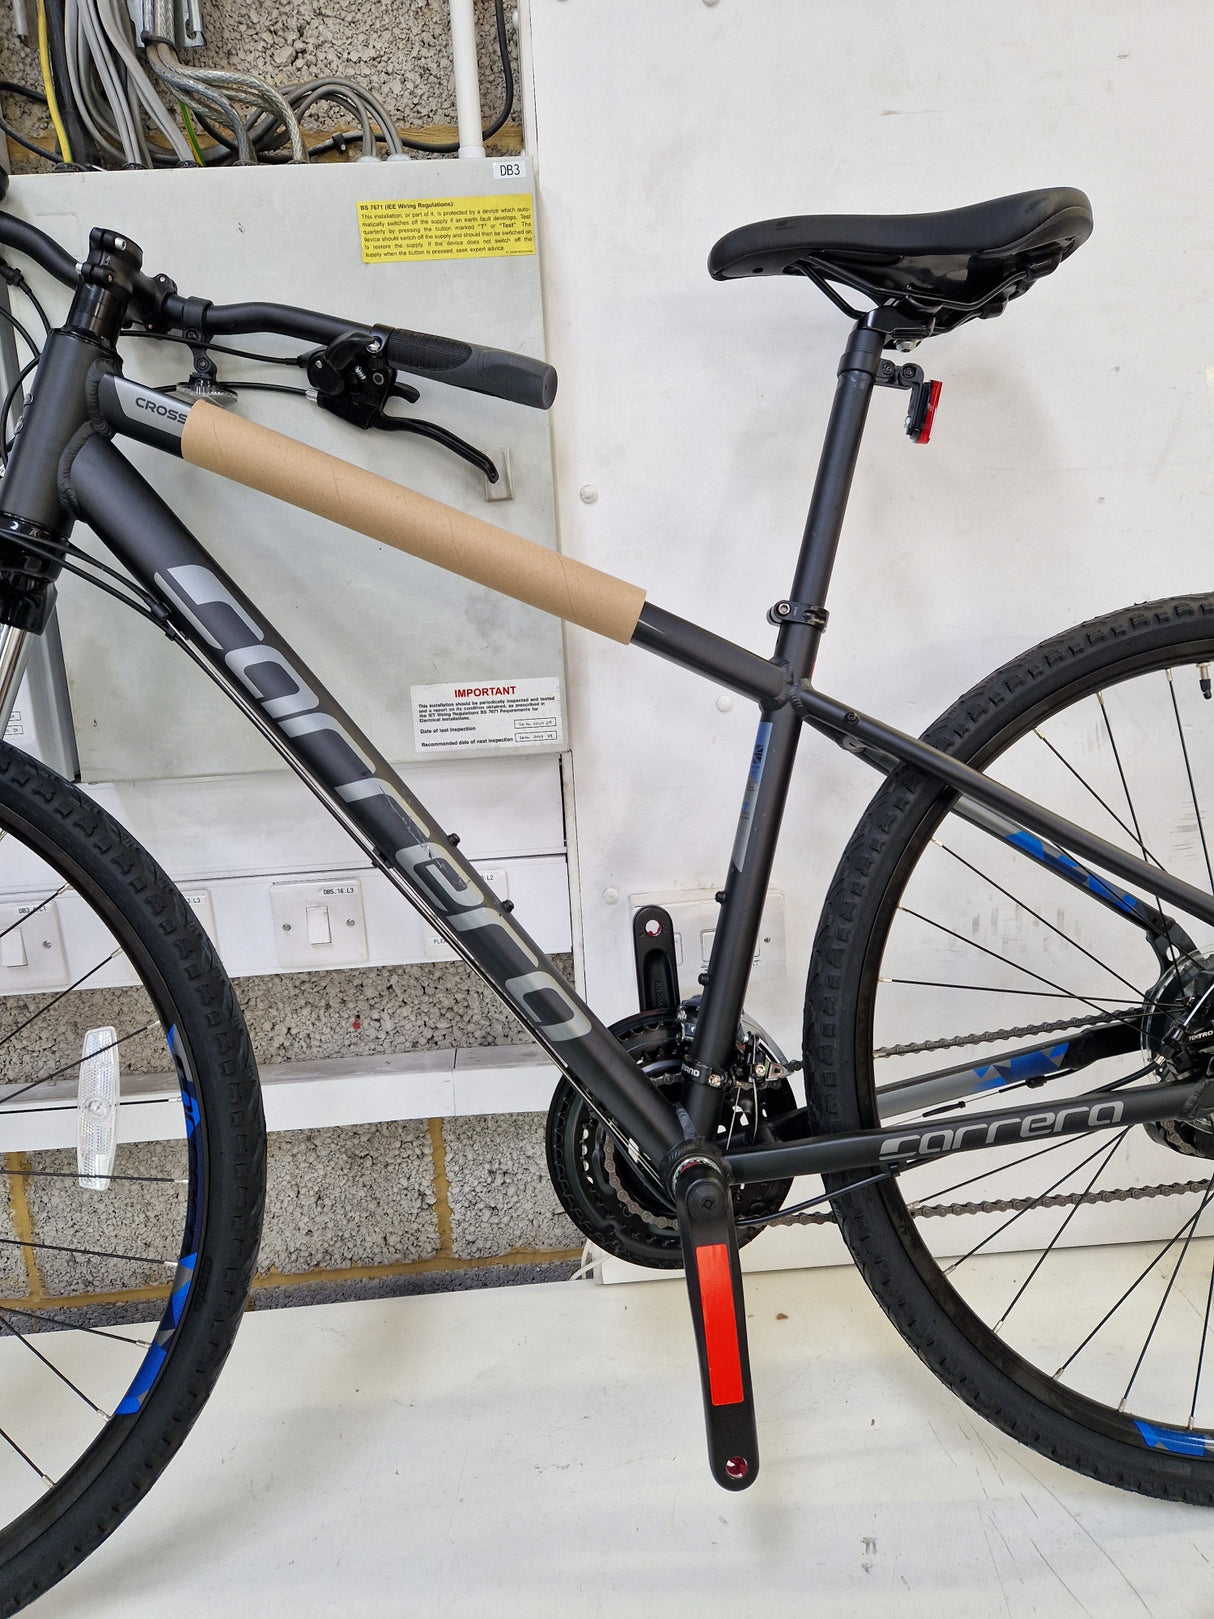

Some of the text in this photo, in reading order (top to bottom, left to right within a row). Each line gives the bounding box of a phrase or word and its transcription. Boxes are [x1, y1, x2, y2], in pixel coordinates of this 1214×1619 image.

[500, 164, 520, 176] DB3
[454, 686, 516, 698] IMPORTANT
[879, 1100, 1124, 1161] carrera
